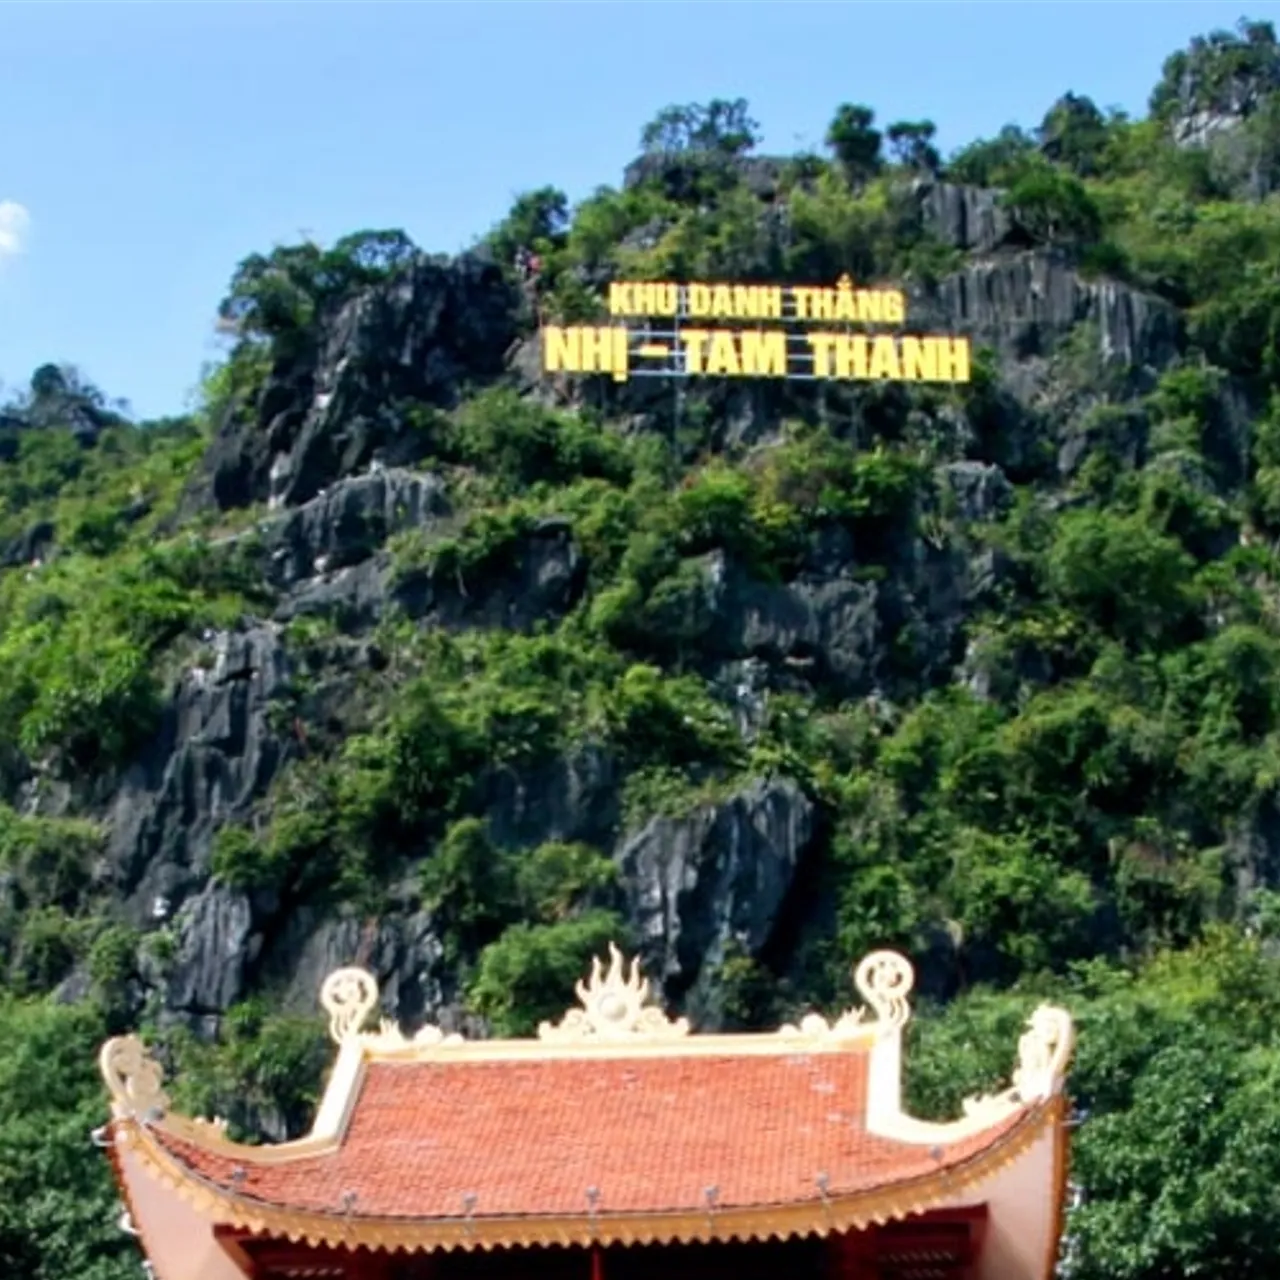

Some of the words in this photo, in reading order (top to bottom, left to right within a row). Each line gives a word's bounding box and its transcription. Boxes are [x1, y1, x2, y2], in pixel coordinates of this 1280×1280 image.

[609, 282, 677, 317] KHU
[687, 283, 781, 319] DANH
[543, 326, 627, 382] NHỊ
[679, 329, 786, 377] TAM
[808, 332, 970, 382] THANH
